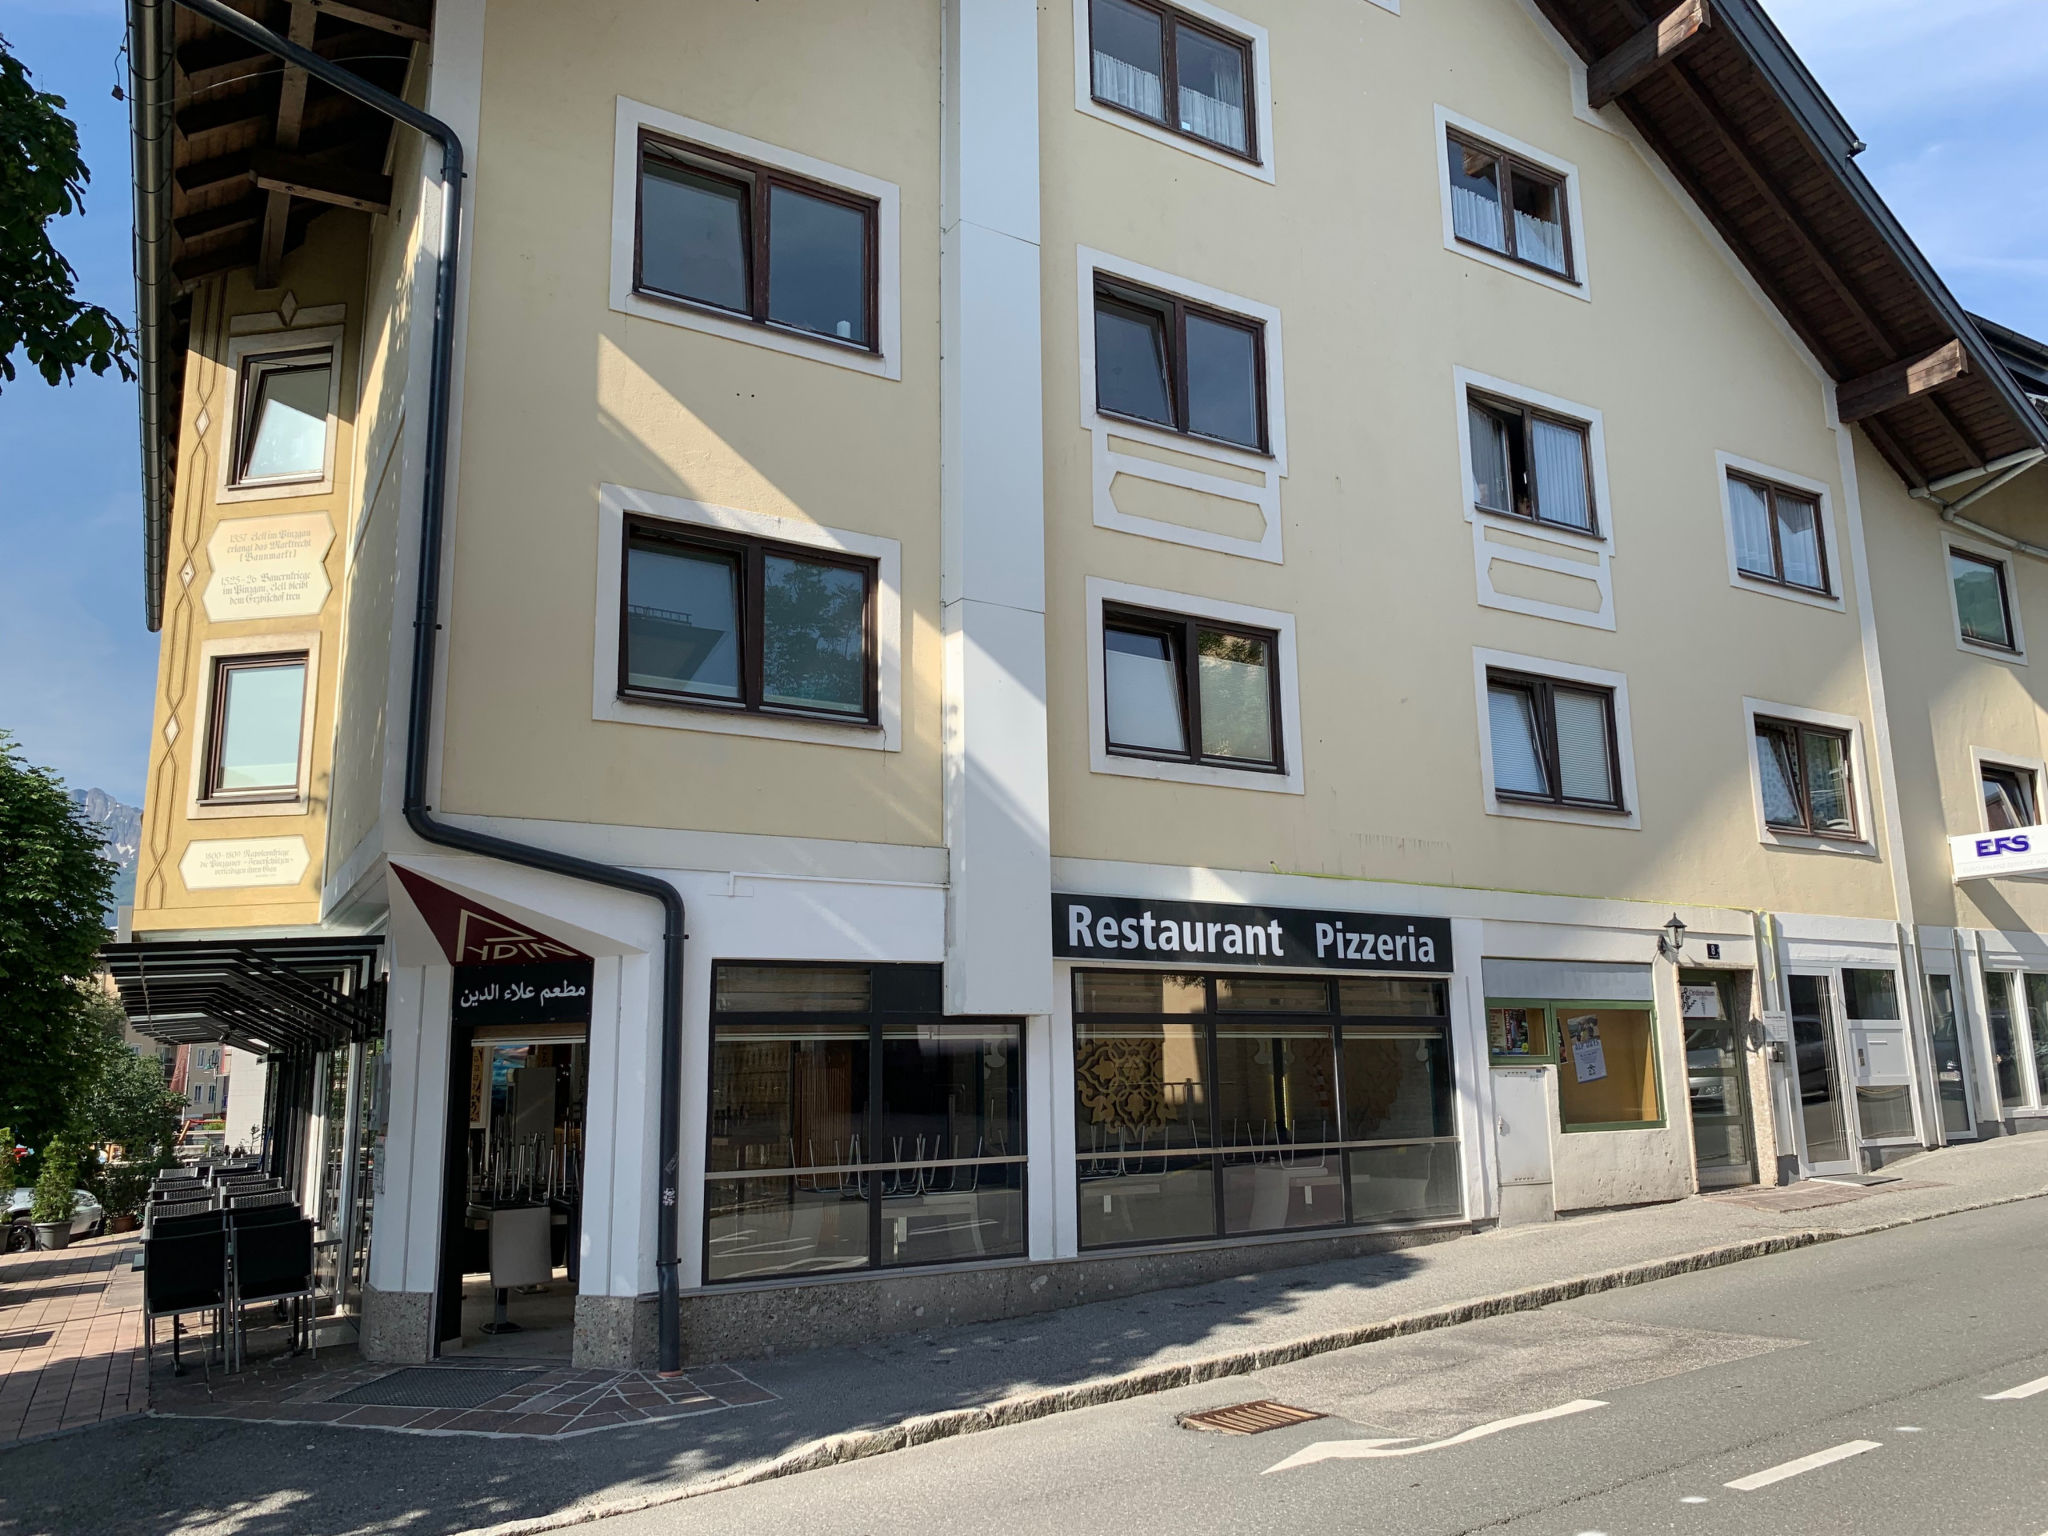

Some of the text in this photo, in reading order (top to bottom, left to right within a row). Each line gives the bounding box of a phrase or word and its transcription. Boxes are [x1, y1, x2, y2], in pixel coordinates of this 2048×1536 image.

[1976, 835, 2030, 857] EFS
[1068, 904, 1436, 963] Restaurant Pizzeria
[460, 979, 586, 1007] مطعم علاء الدين
